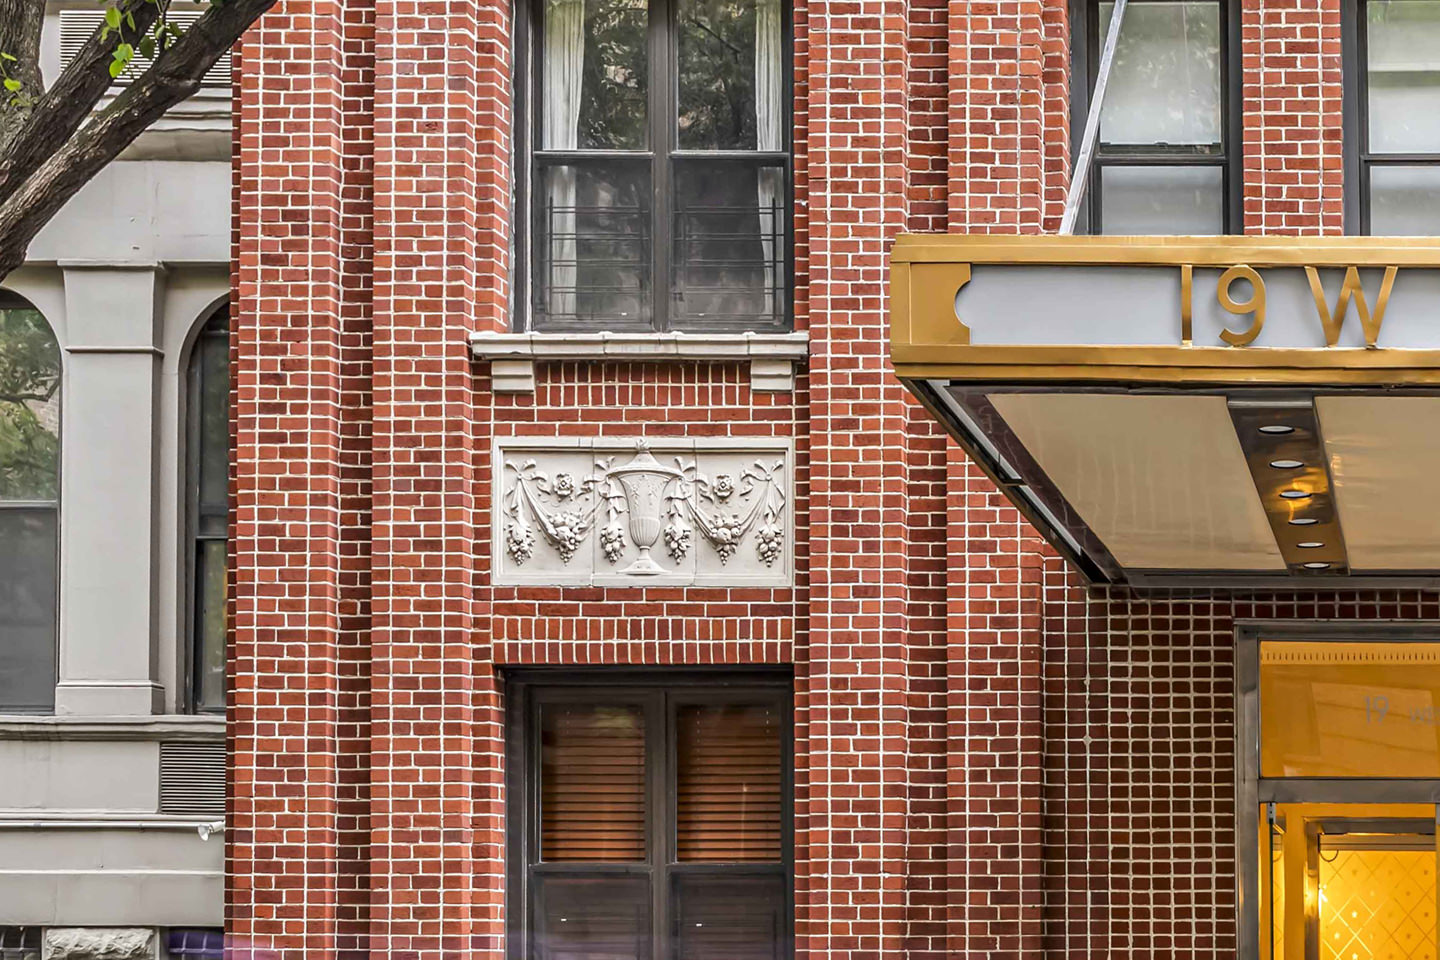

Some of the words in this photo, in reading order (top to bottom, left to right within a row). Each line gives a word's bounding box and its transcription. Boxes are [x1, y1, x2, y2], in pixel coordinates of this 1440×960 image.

[1181, 264, 1266, 348] 19
[1304, 266, 1398, 349] W
[1365, 695, 1390, 726] 19
